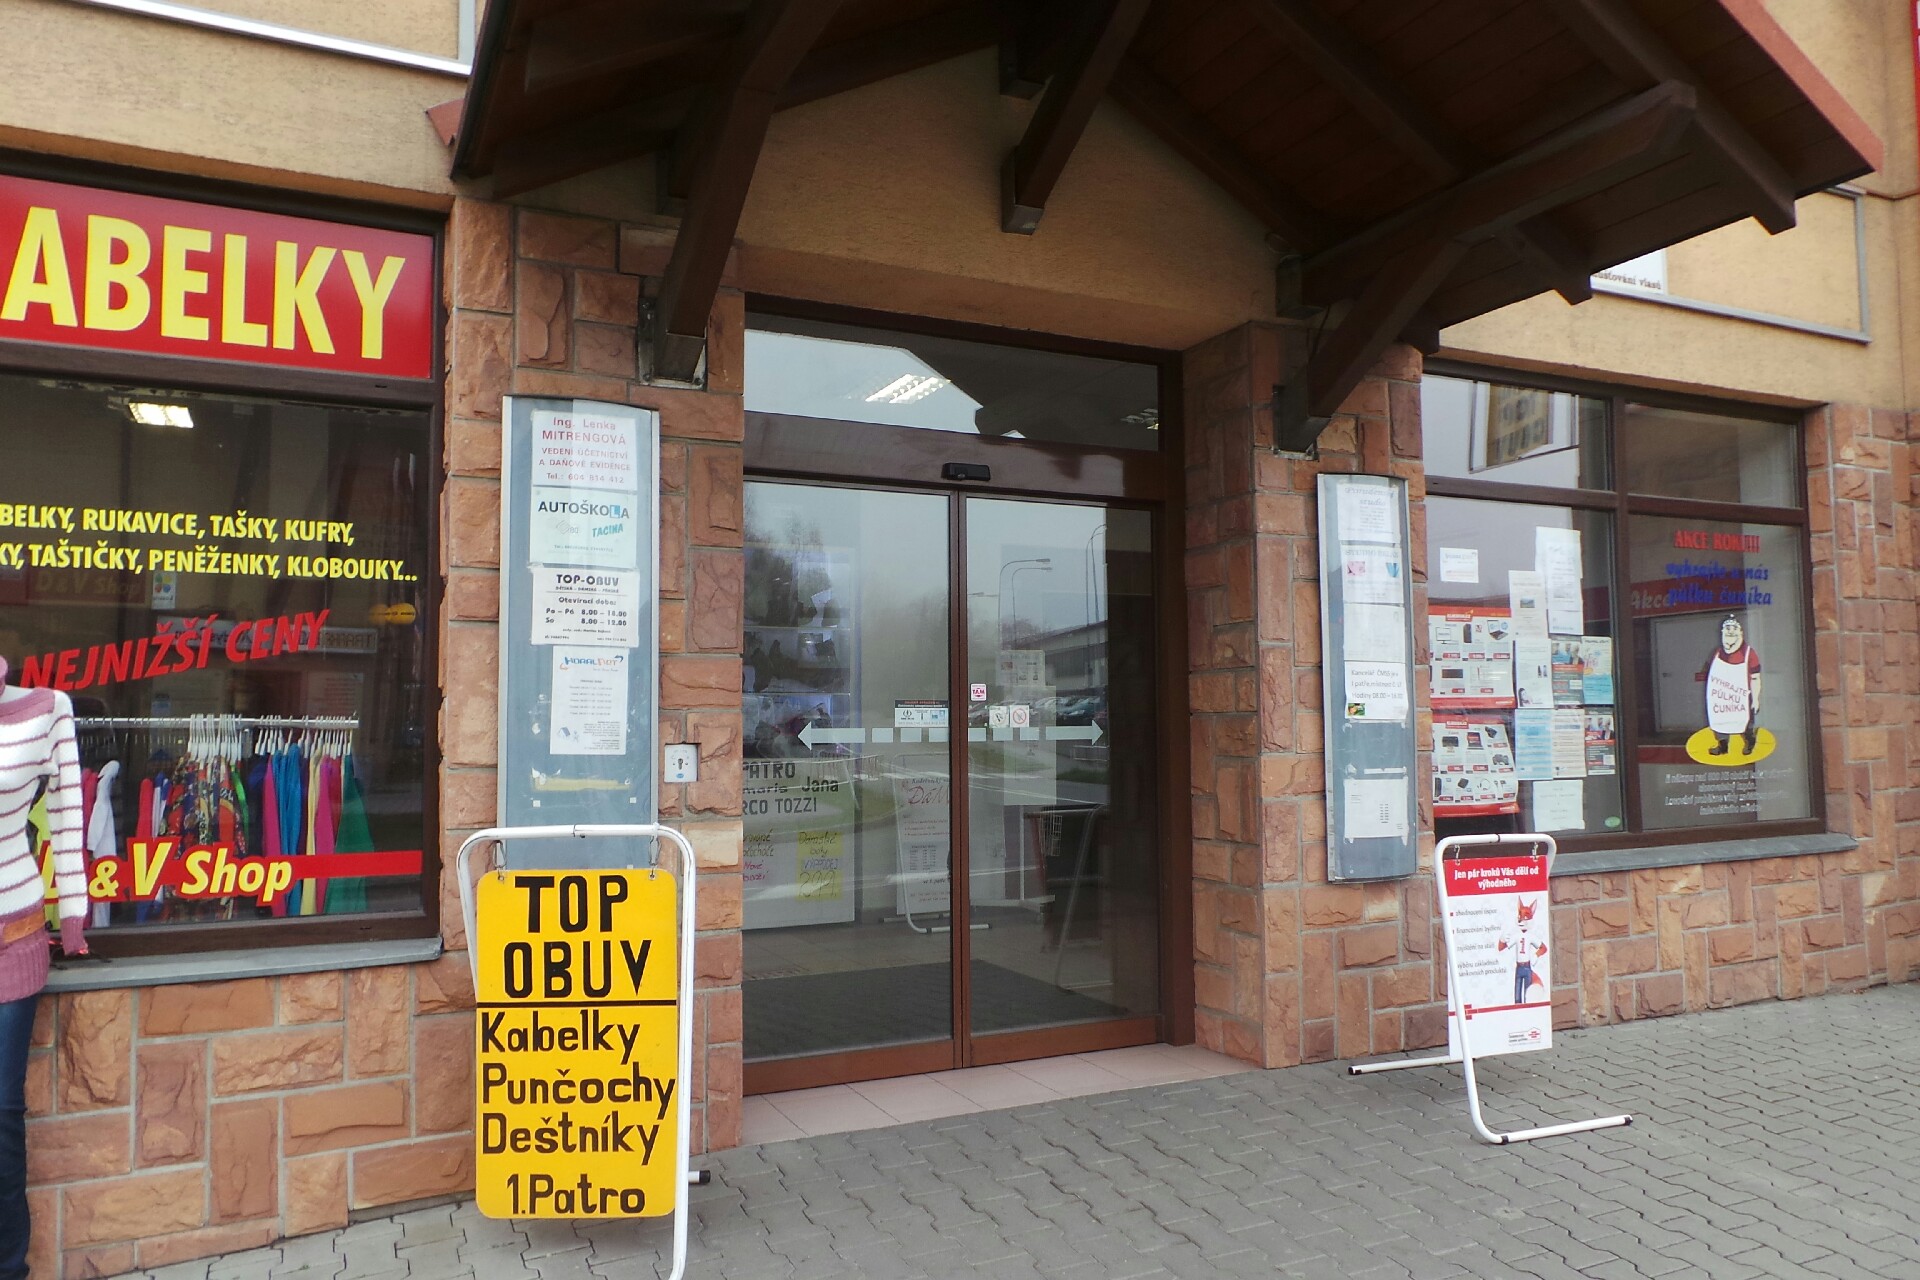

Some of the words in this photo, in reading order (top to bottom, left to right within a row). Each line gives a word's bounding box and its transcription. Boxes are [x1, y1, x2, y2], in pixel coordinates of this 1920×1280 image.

[1, 206, 406, 360] ABELKY
[553, 417, 575, 428] Ing.
[583, 418, 616, 430] Lenka
[542, 430, 626, 445] MITRENGOVÁ
[590, 461, 631, 471] EVIDENCE
[82, 508, 206, 539] RUKAVICE,
[209, 510, 279, 543] TAŠKY,
[284, 519, 355, 546] KUFRY,
[28, 538, 144, 575] TAŠTIČKY,
[149, 545, 281, 579] PENĚŽENKY,
[287, 556, 418, 582] KLOBOUKY...
[556, 574, 619, 587] TOP-OBUV
[1745, 563, 1769, 580] nás
[19, 613, 219, 691] NEJNIŽŠÍ
[225, 608, 330, 663] CENY
[1711, 675, 1748, 697] VYHRAJTE
[1711, 688, 1741, 704] PŮLKU
[1713, 703, 1746, 713] ČUNÍKA
[801, 776, 839, 793] Jana
[775, 797, 817, 814] TOZZI
[88, 860, 120, 898] &
[132, 842, 172, 896] V
[181, 848, 293, 902] Shop
[1454, 869, 1467, 880] Jen
[1468, 869, 1480, 880] pár
[1480, 867, 1500, 877] kroků
[1501, 867, 1514, 876] Vás
[1515, 866, 1529, 875] dělí
[1529, 866, 1539, 875] od
[1478, 878, 1517, 890] výhodného
[514, 875, 628, 934] TOP
[504, 939, 651, 999] OBUV
[481, 1009, 640, 1066] Kabelky
[482, 1061, 676, 1120] Punčochy
[482, 1110, 659, 1166] Deštníky
[506, 1173, 646, 1215] 1.Patro
